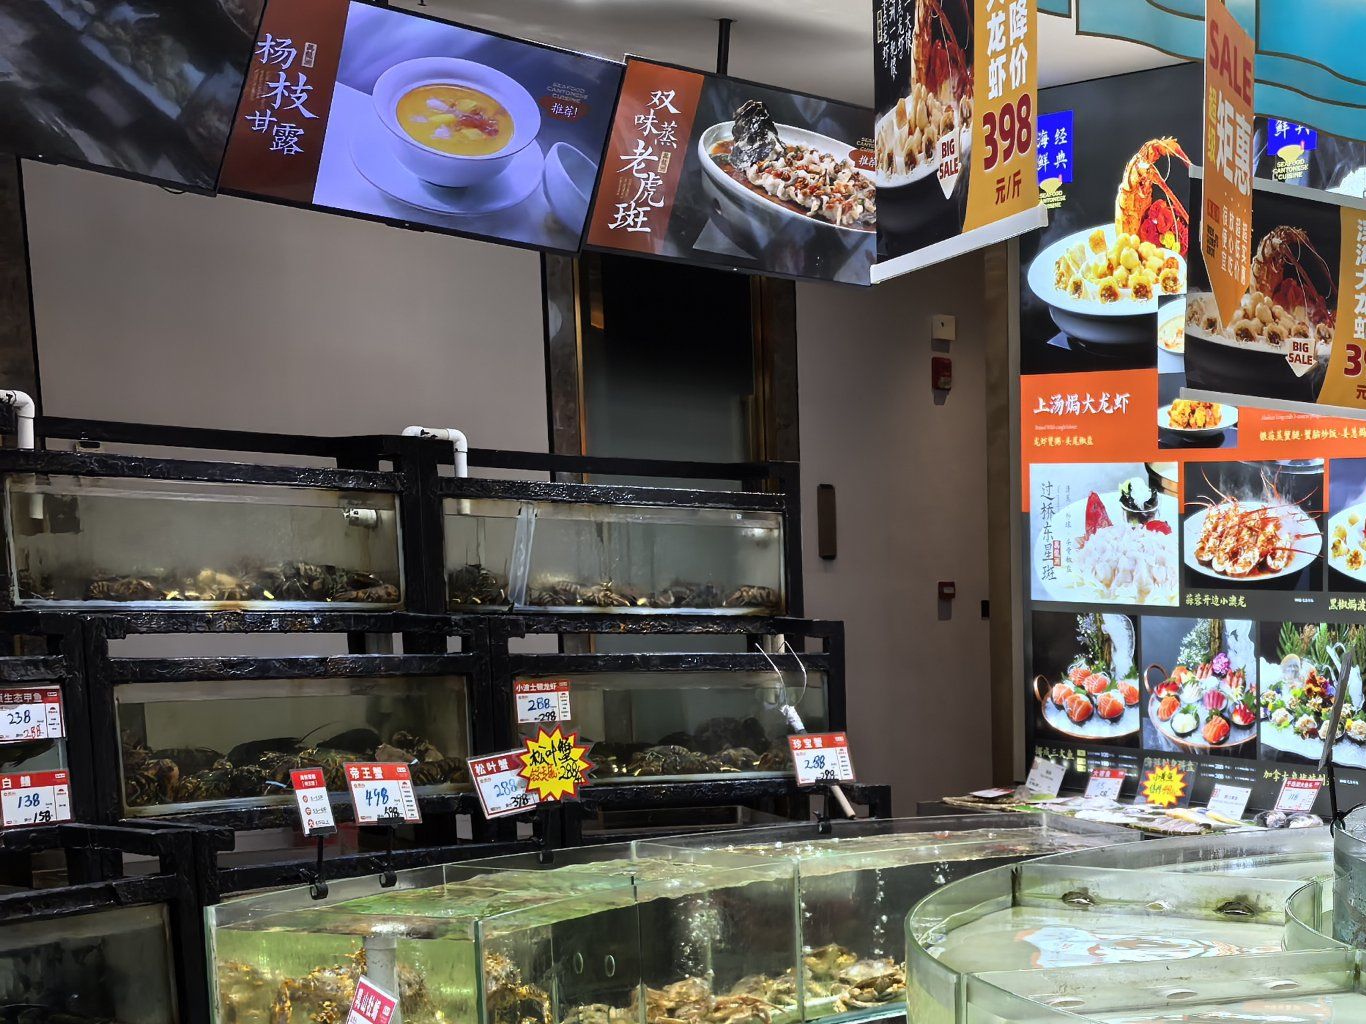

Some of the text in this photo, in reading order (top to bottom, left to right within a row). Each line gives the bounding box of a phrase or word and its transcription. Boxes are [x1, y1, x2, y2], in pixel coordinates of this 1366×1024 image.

[1208, 19, 1252, 105] SALE
[245, 33, 320, 155] 杨枝甘露
[982, 93, 1032, 171] 398
[941, 140, 955, 159] BIG
[608, 90, 682, 233] 双味蒸老虎斑
[939, 159, 959, 181] SALE
[995, 169, 1022, 206] 元/斤
[1292, 340, 1309, 354] BIG
[1288, 352, 1313, 366] SALE
[1033, 392, 1131, 416] 上汤焗大龙虾
[527, 697, 551, 712] 288
[7, 710, 31, 725] 238
[792, 737, 823, 750] 珍宝蟹
[349, 766, 384, 780] 帝王蟹
[474, 758, 510, 775] 松叶蟹
[365, 787, 389, 807] 498
[493, 778, 517, 798] 288
[18, 793, 40, 808] 138
[34, 810, 51, 823] 158
